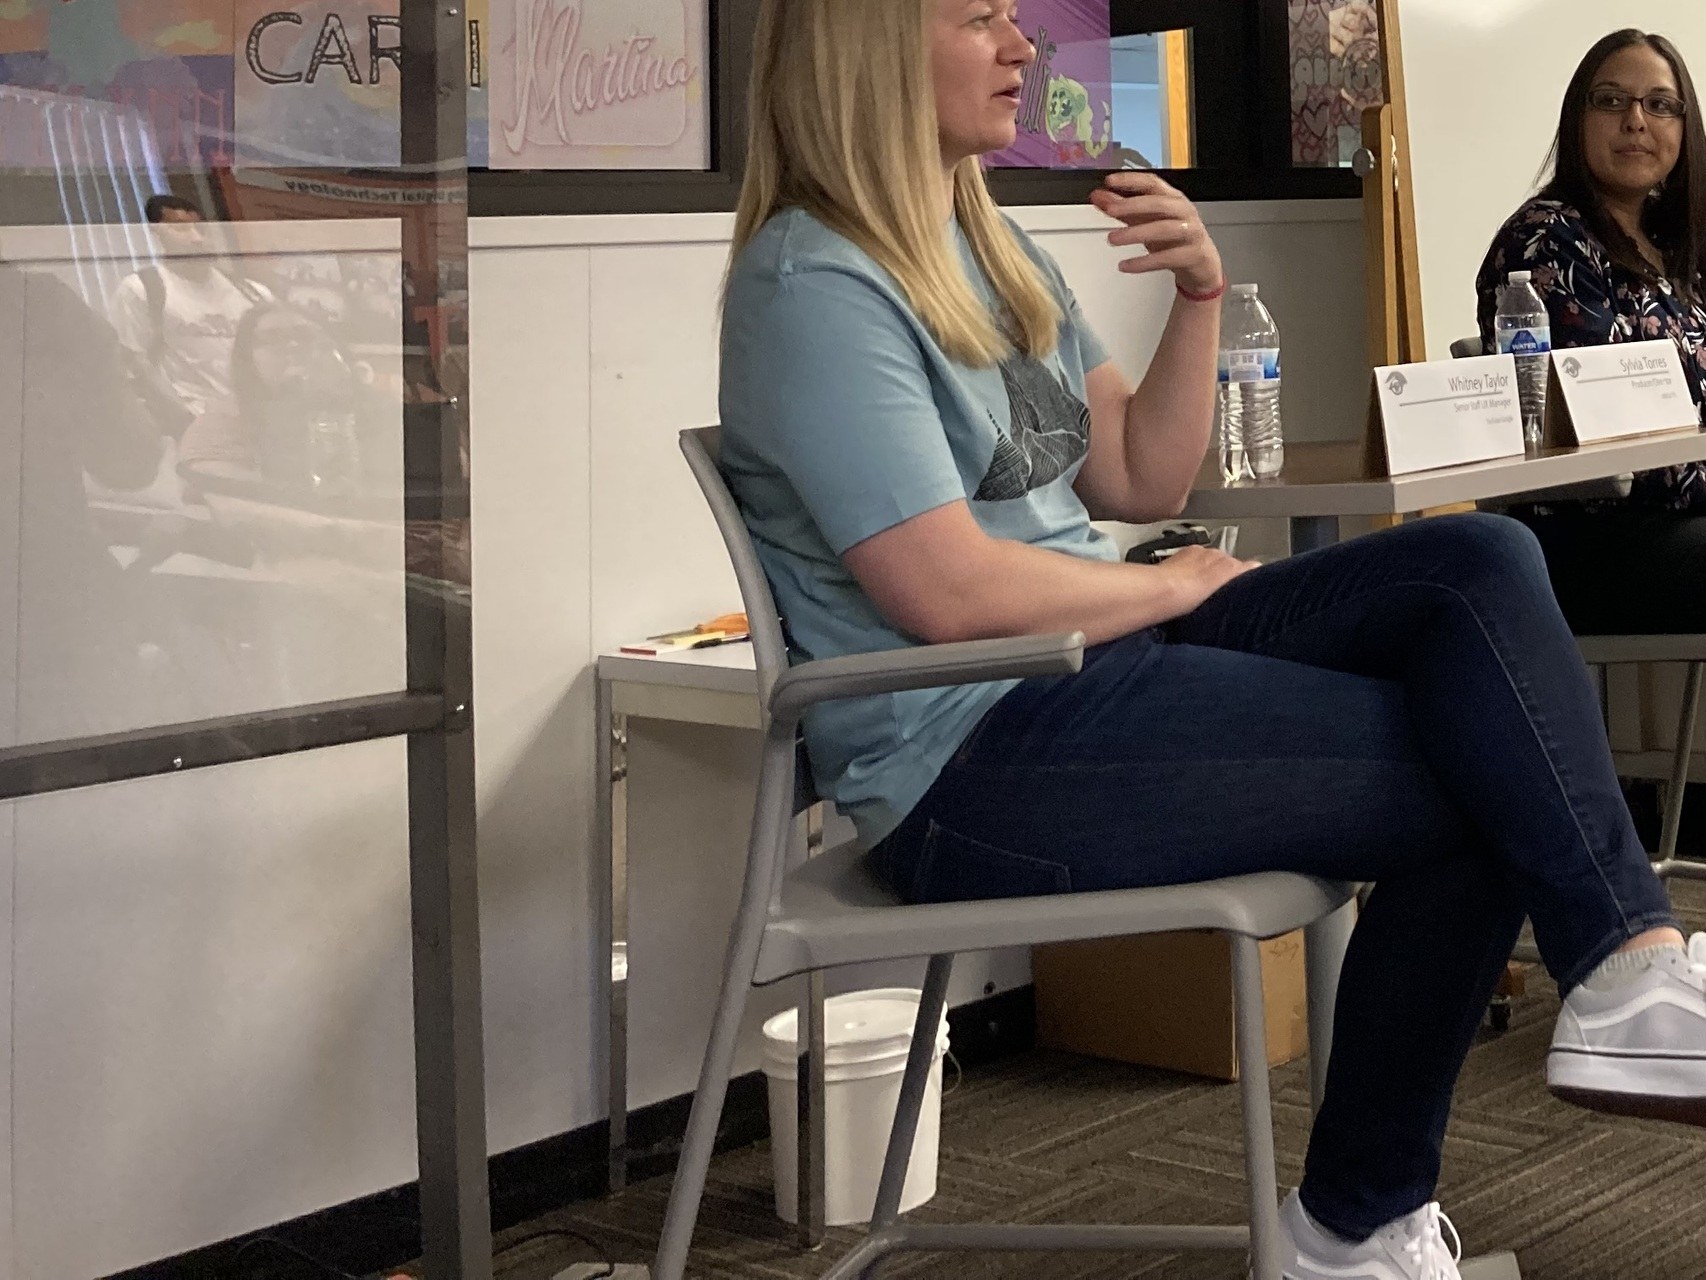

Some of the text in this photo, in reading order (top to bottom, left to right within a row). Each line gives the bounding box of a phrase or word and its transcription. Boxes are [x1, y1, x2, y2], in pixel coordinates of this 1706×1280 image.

[246, 12, 480, 87] CARI
[1511, 342, 1537, 351] WATER
[1620, 357, 1667, 375] Sylvia Torres
[1448, 373, 1508, 393] Whitney Taylor
